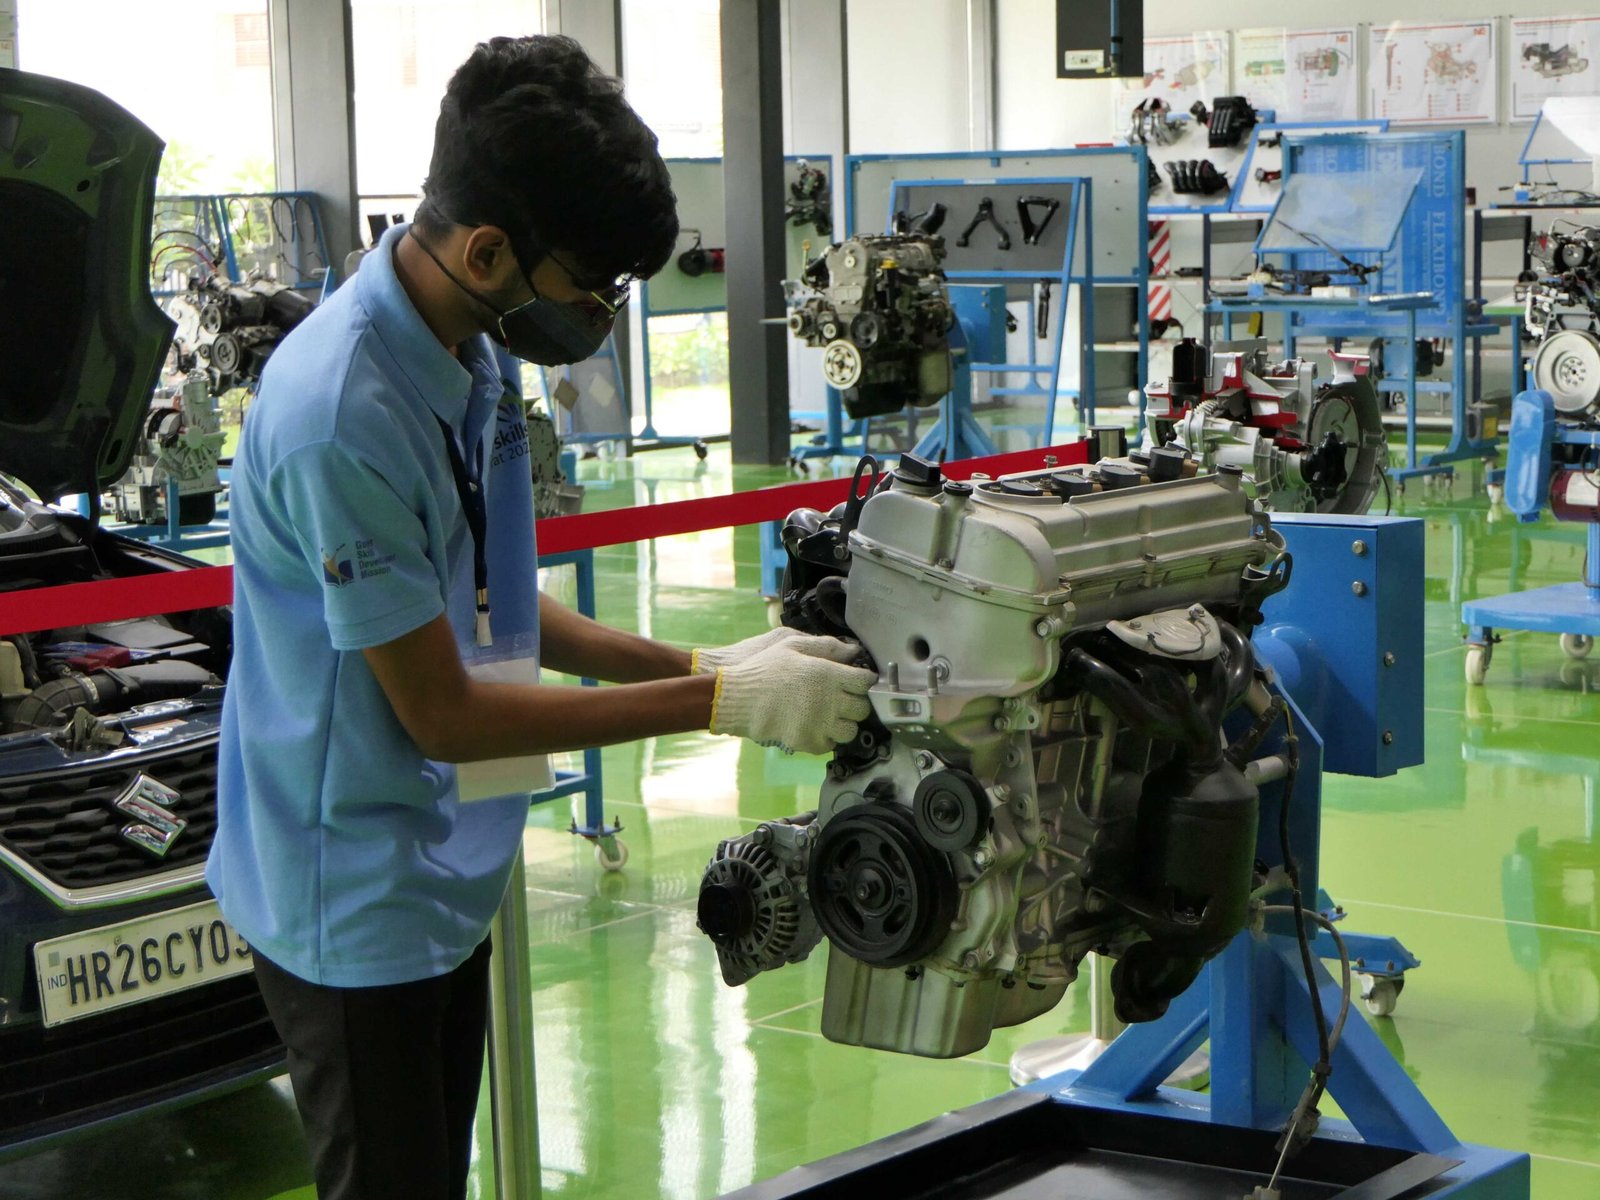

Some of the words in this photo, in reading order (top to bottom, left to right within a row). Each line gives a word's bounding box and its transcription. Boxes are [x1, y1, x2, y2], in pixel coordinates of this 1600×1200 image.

[1433, 144, 1447, 198] BOND
[1432, 211, 1447, 316] FLEXIBOND
[47, 973, 68, 991] IND
